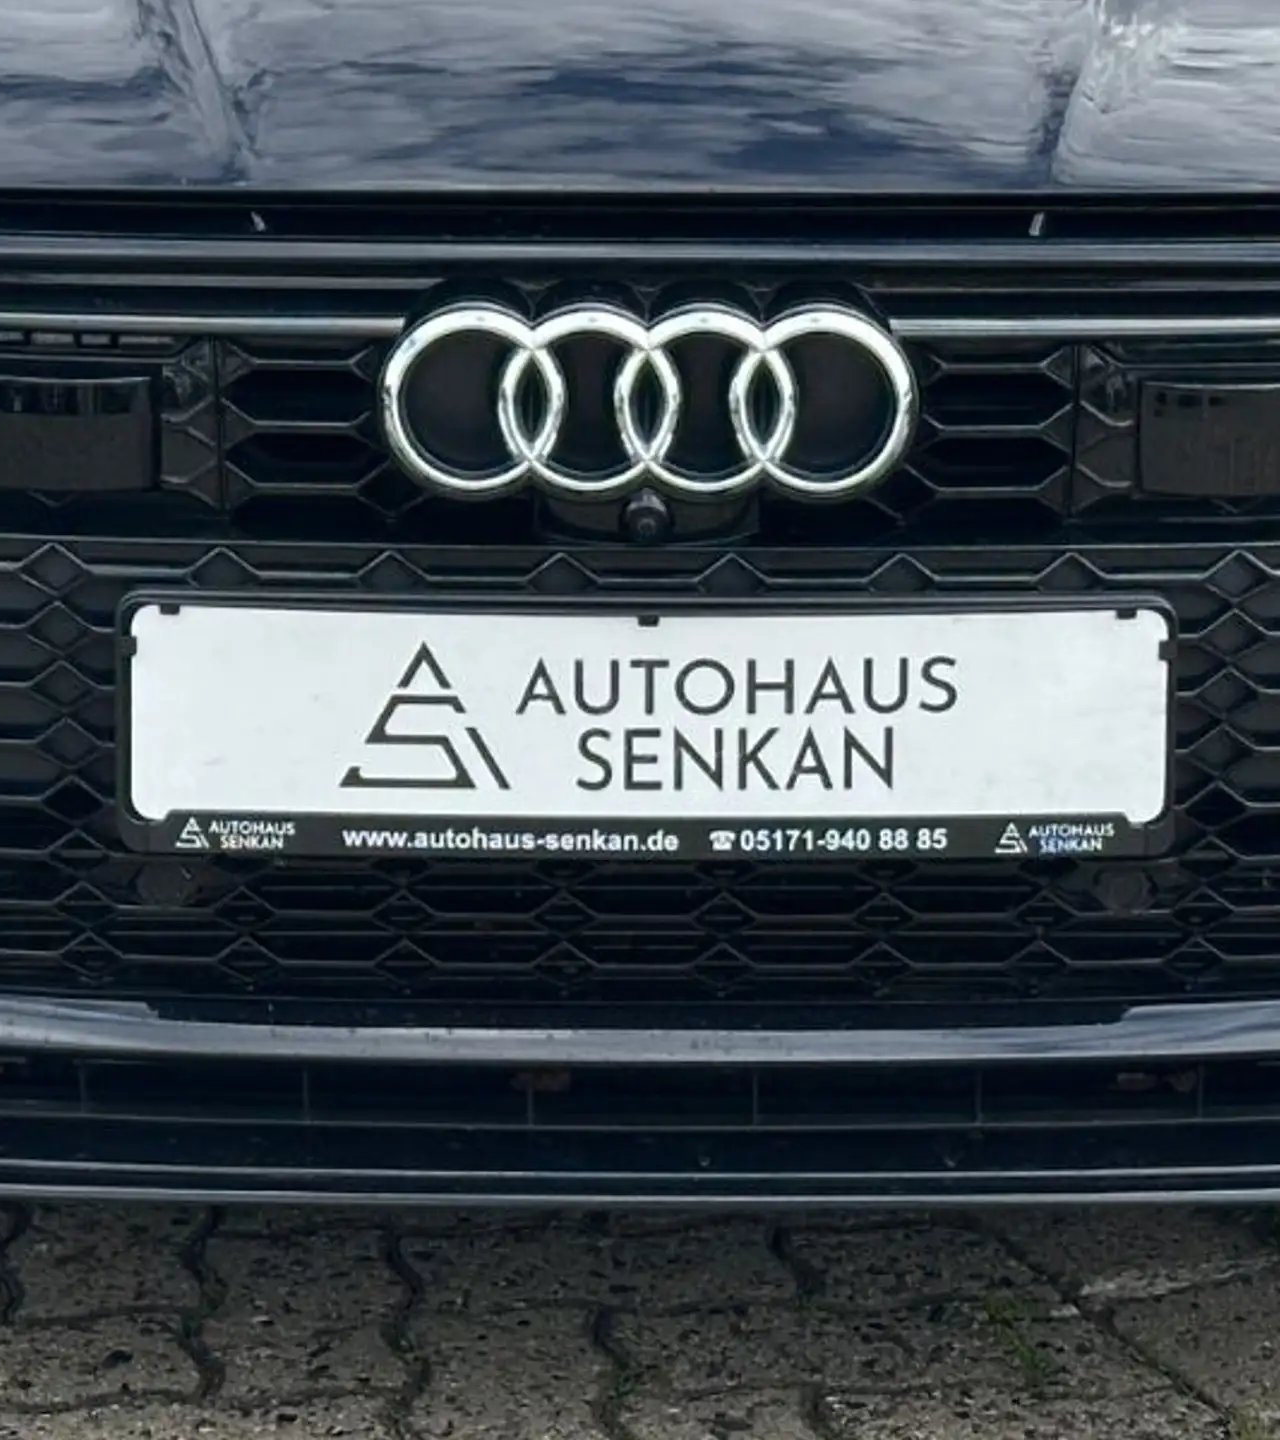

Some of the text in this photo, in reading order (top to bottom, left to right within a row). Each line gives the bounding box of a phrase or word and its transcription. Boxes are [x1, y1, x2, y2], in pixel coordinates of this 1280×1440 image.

[516, 656, 958, 715] AUTOHAUS
[576, 726, 894, 790] SENKAN
[208, 820, 296, 836] AUTOHAUS
[1028, 822, 1116, 838] AUTOHAUS
[220, 834, 285, 849] SENKAN
[342, 826, 948, 852] www.autohaus-senkan.de 05171-940 88 85
[1039, 836, 1103, 852] SENKAN
